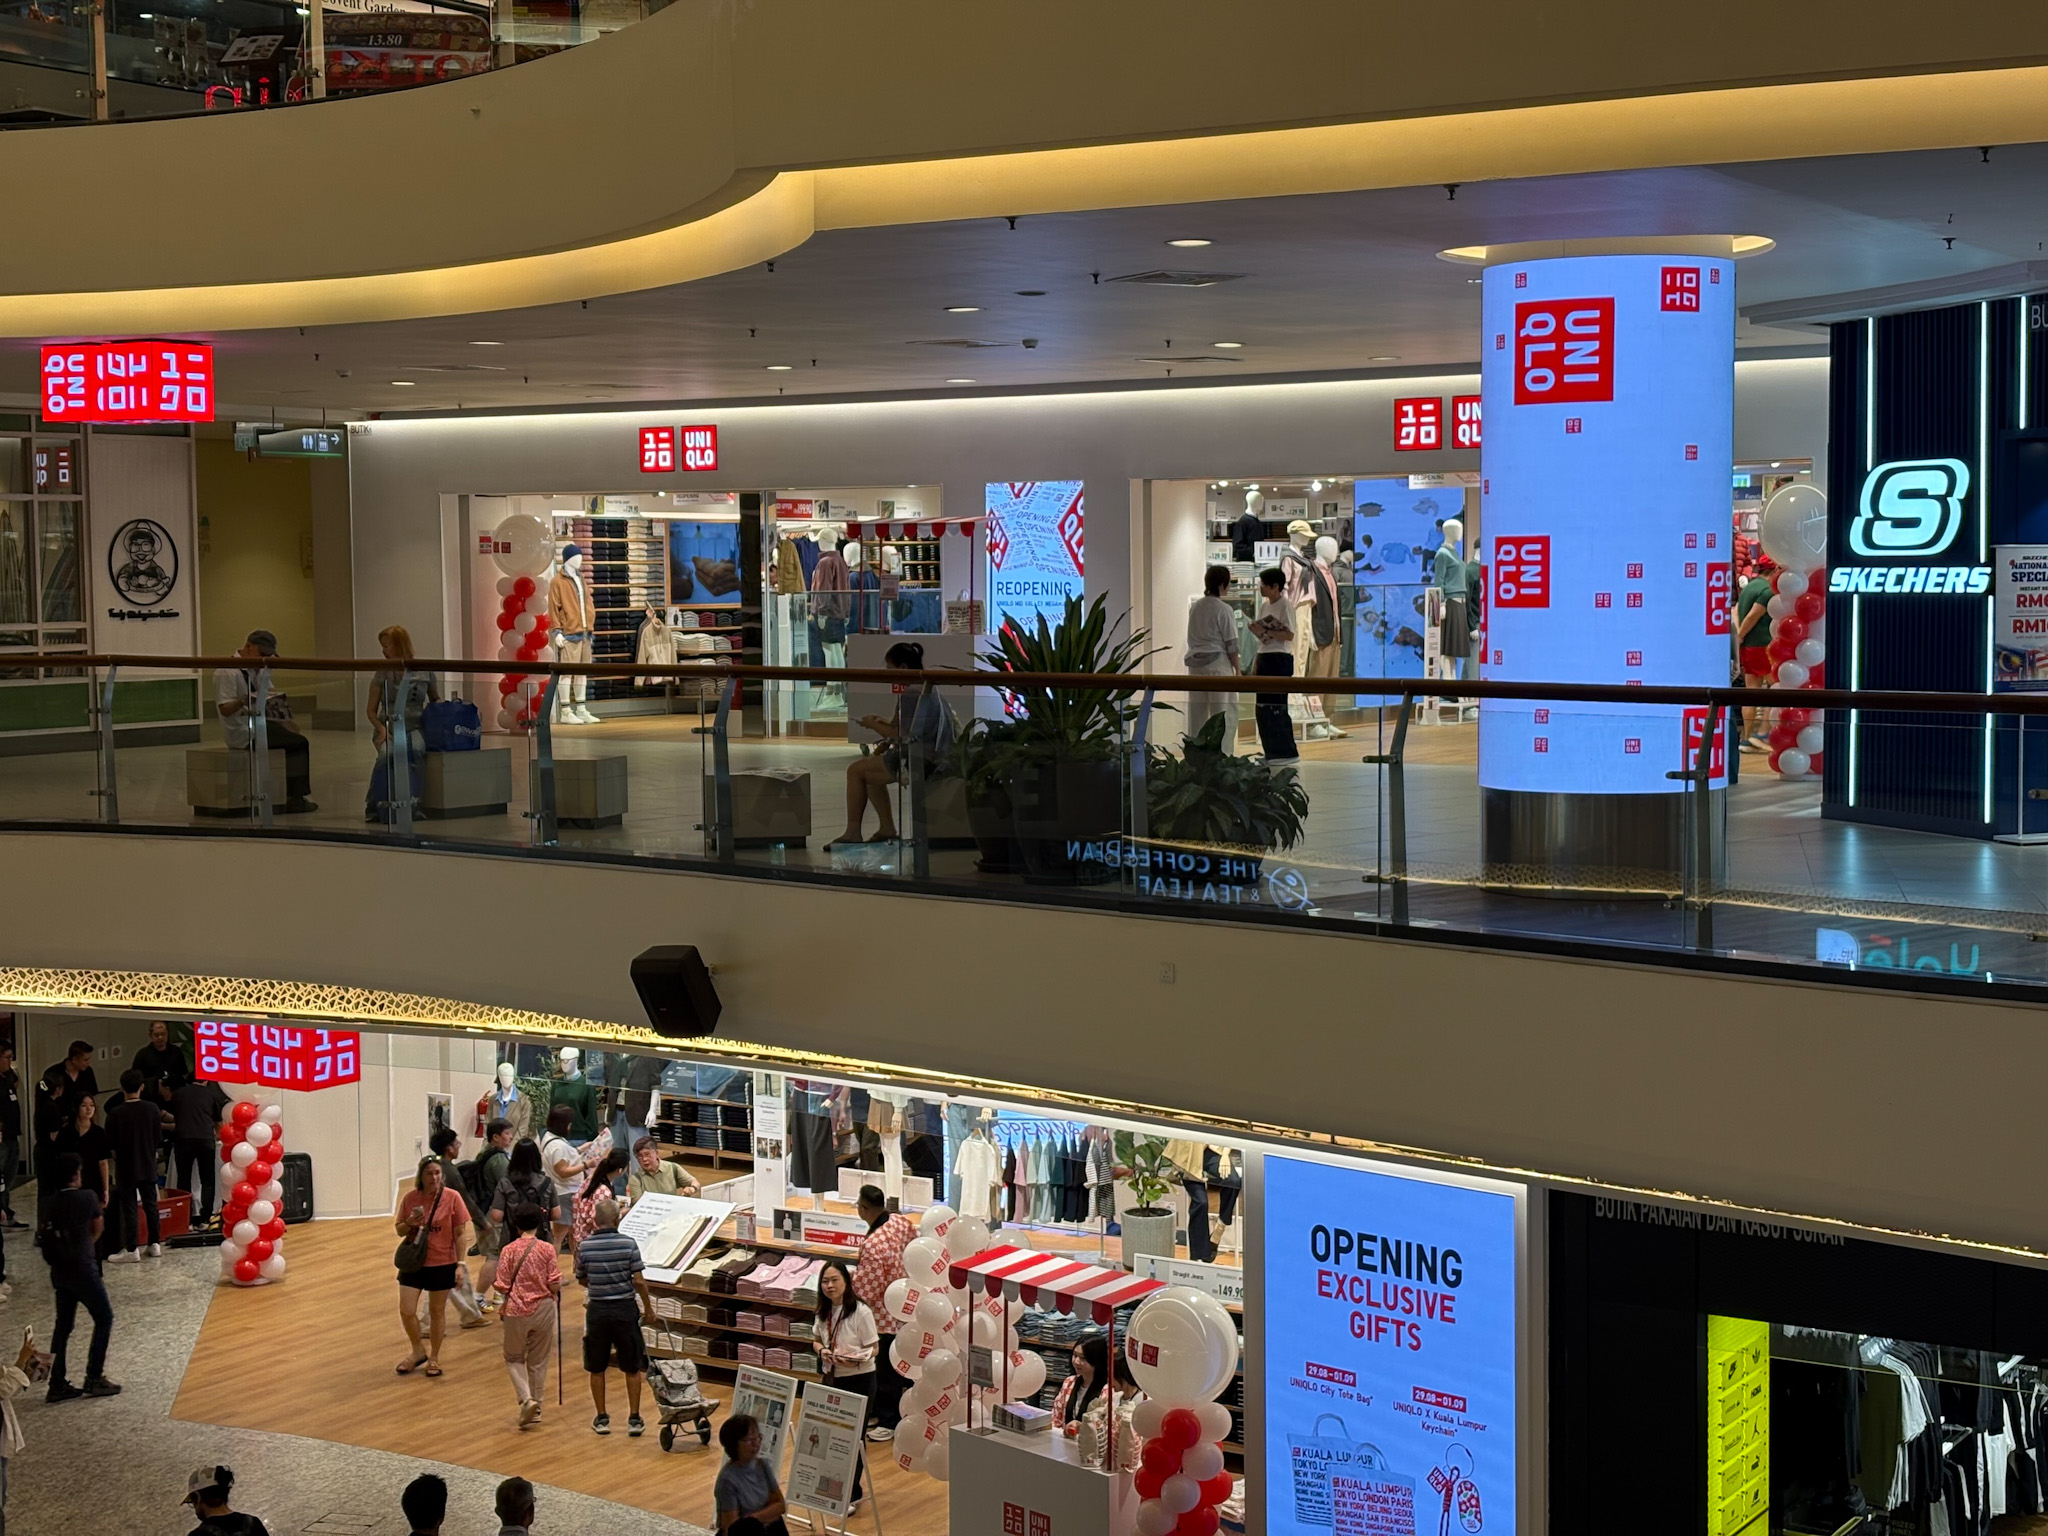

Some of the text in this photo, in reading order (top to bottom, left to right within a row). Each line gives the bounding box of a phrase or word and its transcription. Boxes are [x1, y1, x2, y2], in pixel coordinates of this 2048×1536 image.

[368, 35, 402, 46] 13.80
[1519, 312, 1556, 392] QLO
[1564, 309, 1600, 383] UNI
[1458, 402, 1481, 421] UN
[685, 431, 711, 448] UNI
[1458, 424, 1481, 445] QL
[685, 449, 714, 469] QLO
[1497, 544, 1516, 600] QLO
[1520, 543, 1542, 594] UNI
[2011, 572, 2048, 582] SPECI
[997, 581, 1072, 596] REOPENING
[1829, 567, 1992, 593] SKECHERS
[1709, 570, 1724, 626] QLO
[2013, 619, 2048, 633] RM1
[1595, 1196, 1637, 1221] BUTIK
[1311, 1224, 1463, 1288] OPENING
[1172, 1270, 1190, 1278] Straight
[1317, 1268, 1456, 1324] EXCLUSIVE
[1350, 1310, 1422, 1351] GIFTS
[1290, 1376, 1318, 1392] UNIQLO
[1320, 1384, 1336, 1398] City
[1338, 1388, 1354, 1401] Tote
[1393, 1400, 1423, 1417] UNIQLO
[1433, 1410, 1454, 1425] Kuala
[1457, 1415, 1488, 1432] Lumpur
[1302, 1448, 1333, 1460] KUALA
[1293, 1458, 1318, 1471] TOKYO
[1310, 1472, 1326, 1480] YORK
[1341, 1478, 1414, 1498] KUALA LUMPUR
[1333, 1489, 1414, 1509] TOKYO LONDON PARIS
[1334, 1500, 1347, 1508] NEW
[1349, 1501, 1365, 1510] YORK
[1393, 1506, 1414, 1518] SEOUL
[1366, 1512, 1379, 1521] SAN
